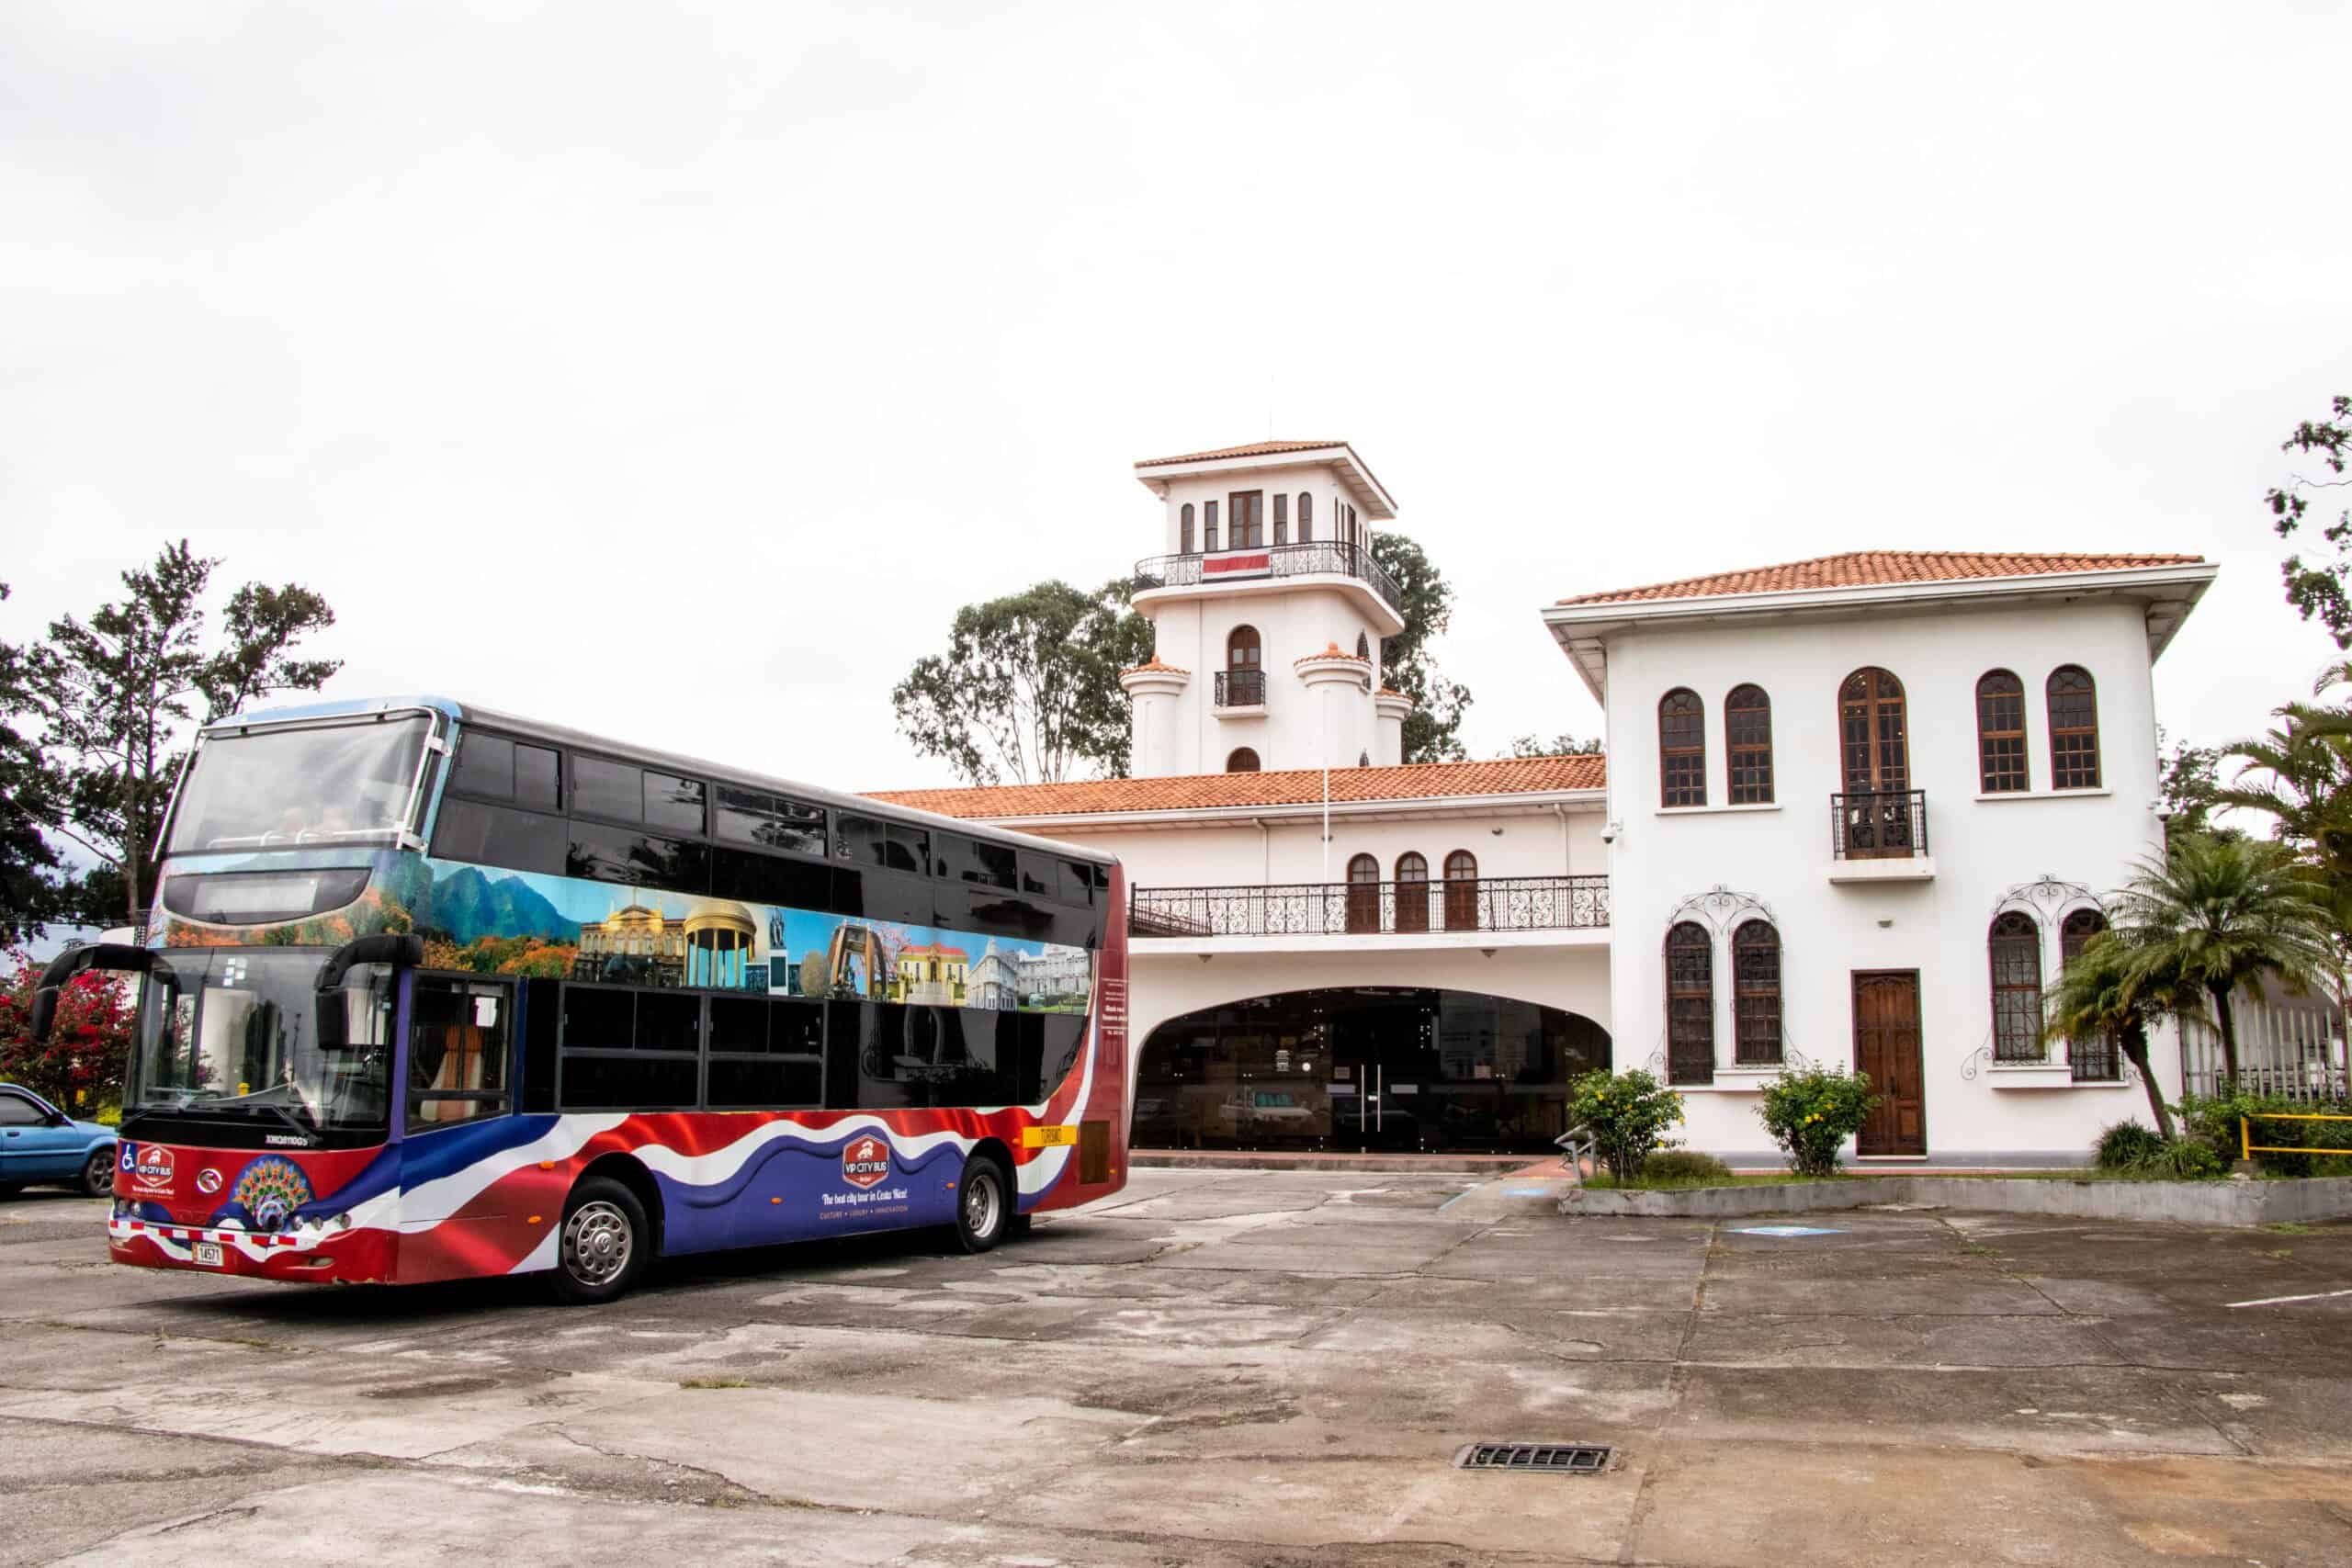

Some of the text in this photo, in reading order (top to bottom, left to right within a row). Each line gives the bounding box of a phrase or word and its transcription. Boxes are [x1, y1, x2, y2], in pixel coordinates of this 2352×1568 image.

[147, 1166, 160, 1174] CITY
[160, 1168, 171, 1176] BUS
[845, 1162, 887, 1173] VIP CITY BUS
[822, 1193, 833, 1205] The
[834, 1193, 846, 1204] best
[846, 1192, 857, 1205] city
[199, 1247, 220, 1261] 14571
